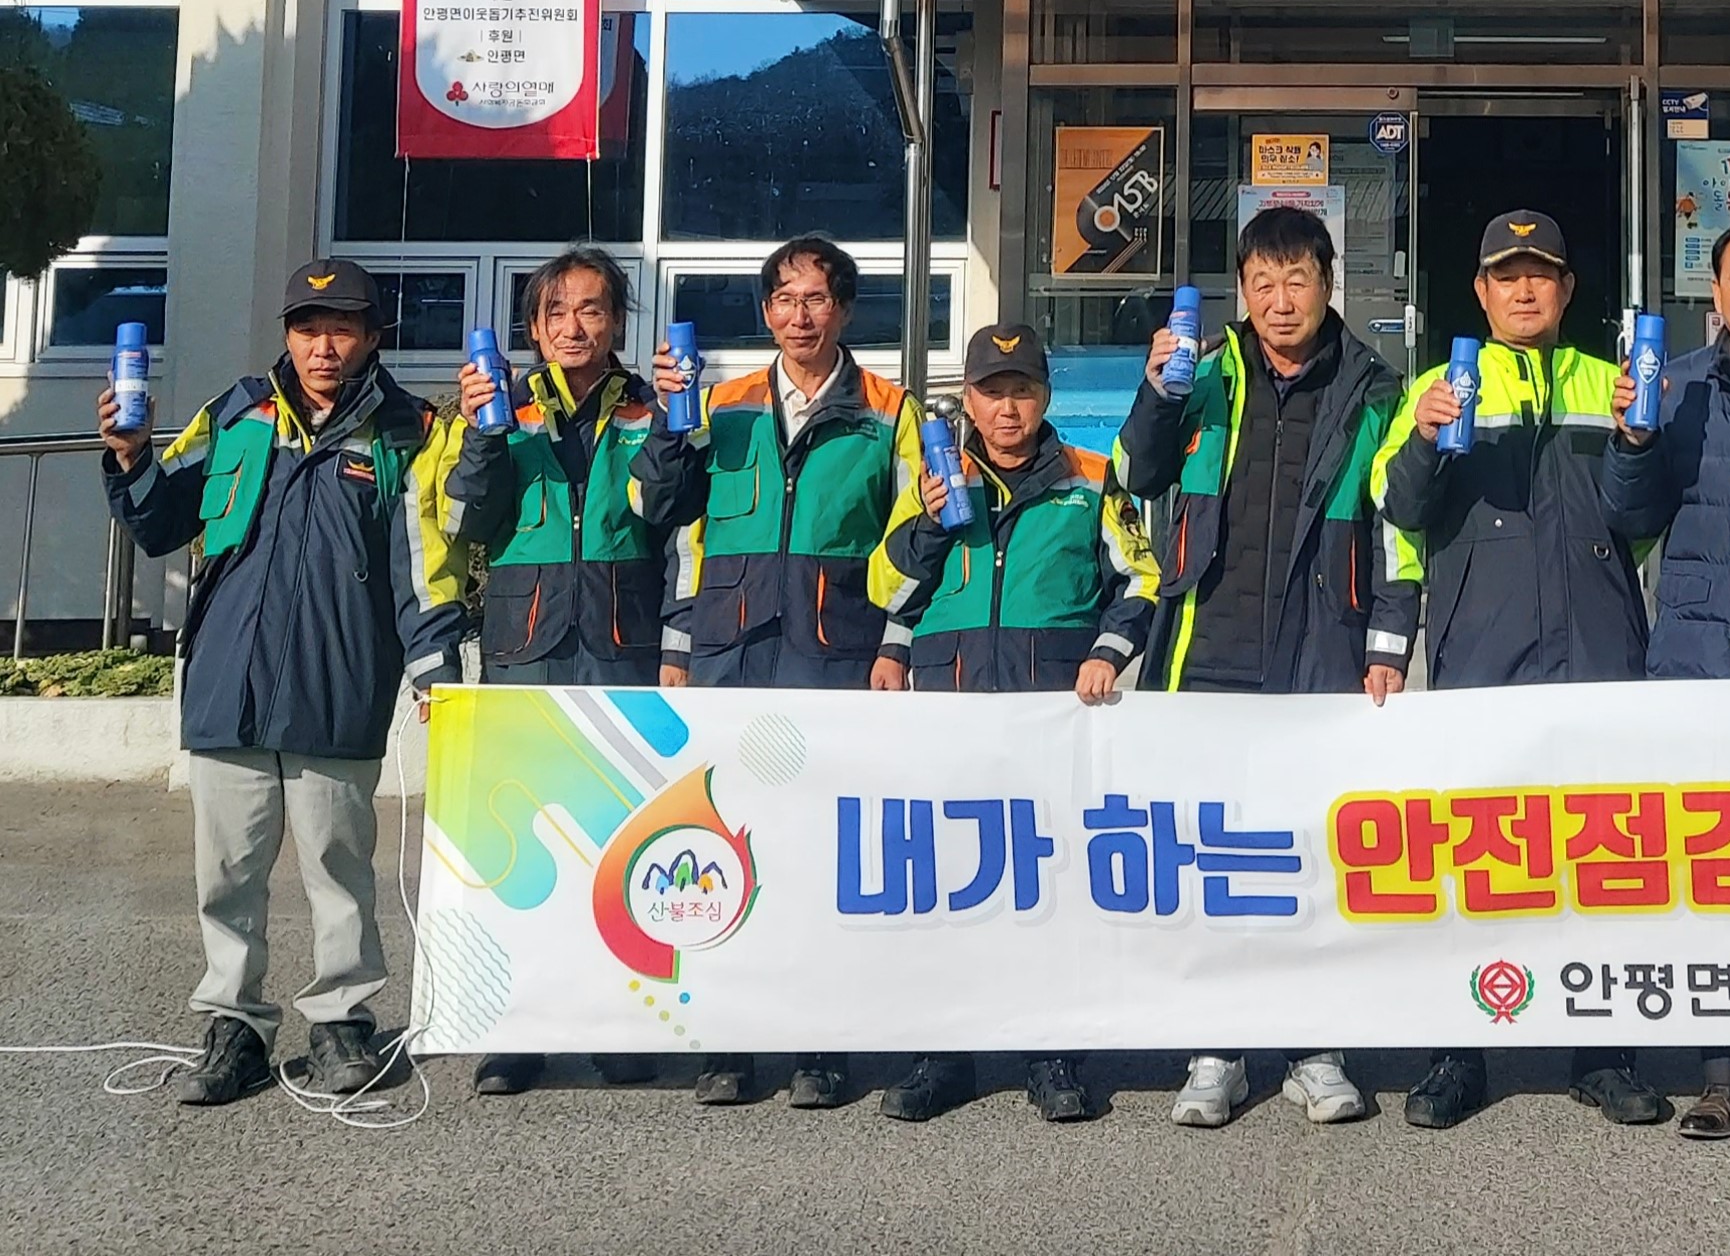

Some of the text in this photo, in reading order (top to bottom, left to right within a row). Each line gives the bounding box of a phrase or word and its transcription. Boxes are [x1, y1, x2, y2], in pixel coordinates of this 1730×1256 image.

[423, 7, 578, 22] 안평면이웃돕기추진위원회
[488, 29, 514, 43] 후원
[487, 49, 526, 64] 안평면
[472, 80, 555, 98] 사랑의열매
[1376, 124, 1404, 140] ADT
[836, 795, 1055, 917] 내가
[1083, 793, 1299, 917] 하는
[648, 900, 722, 923] 산불조심
